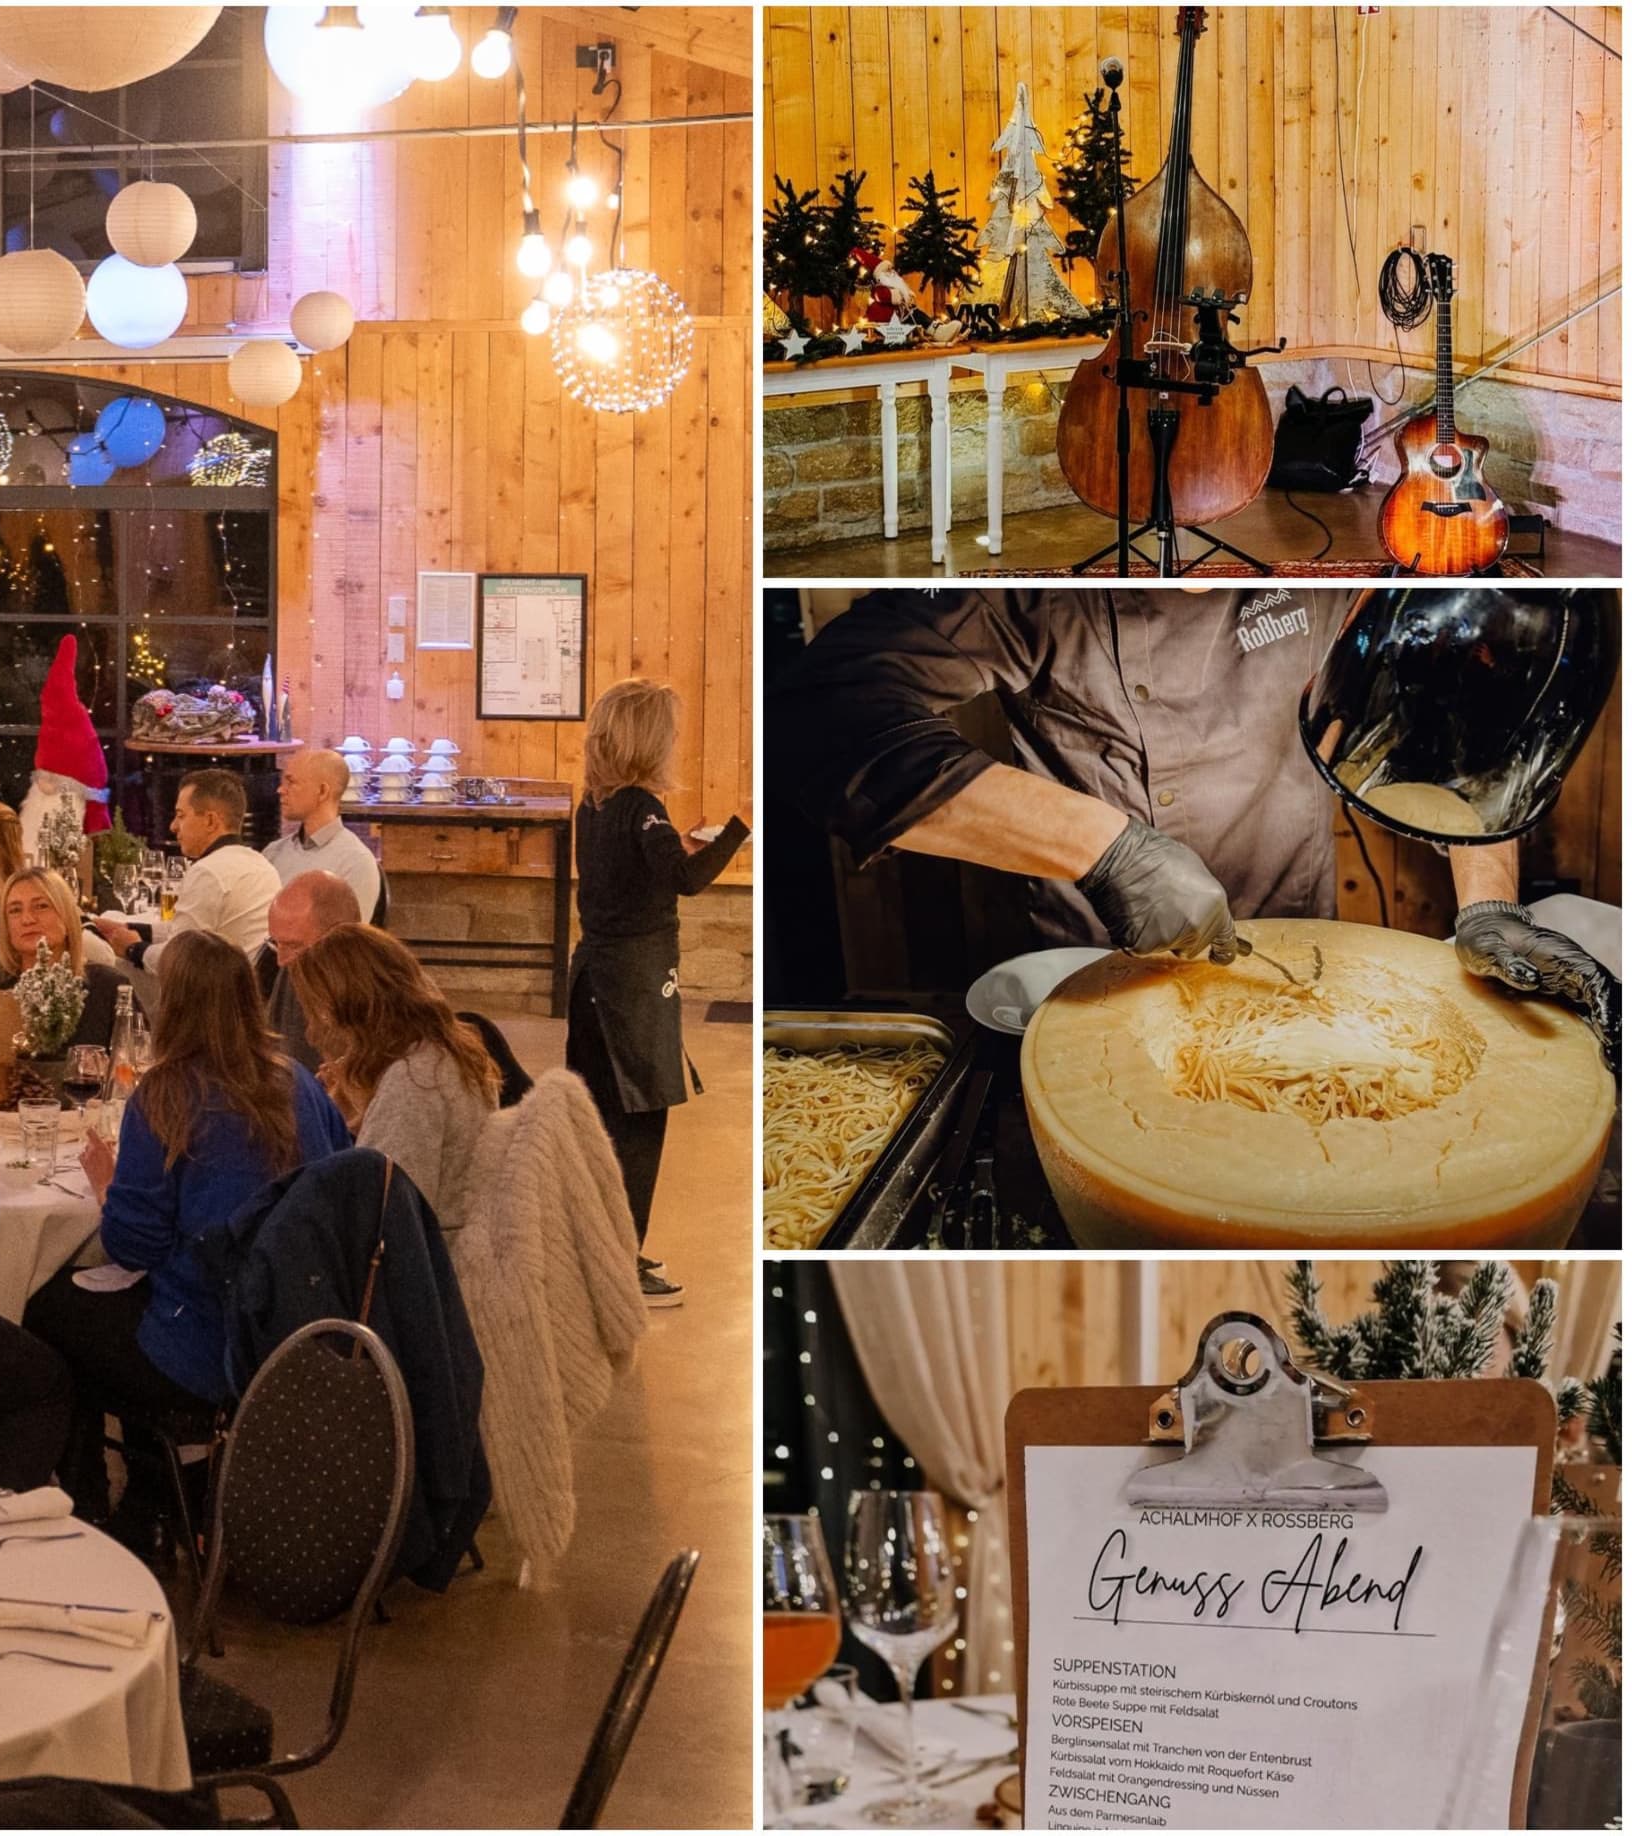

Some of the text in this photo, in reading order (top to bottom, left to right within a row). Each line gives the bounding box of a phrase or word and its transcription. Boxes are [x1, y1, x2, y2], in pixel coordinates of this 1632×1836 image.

[1236, 607, 1310, 653] Roßberg
[1139, 1511, 1354, 1529] ACHALMHOF X ROSSBERG
[1088, 1528, 1423, 1634] Genuss Abend
[1053, 1658, 1176, 1679] SUPPENSTATION
[1052, 1679, 1358, 1711] Kürbissuppe mit steirischem Kürbiskernöl und Croutons
[1052, 1695, 1219, 1719] Rote Beete Suppe mit Feldsalat
[1052, 1714, 1143, 1734] VORSPEISEN
[1051, 1734, 1312, 1767] Berglinsensalat mit Tranchen von der Entenbrust
[1050, 1751, 1294, 1783] Kürbissalat vom Hokkaido mit Roquefort Käse
[1048, 1784, 1171, 1809] ZWISCHENGANG
[1049, 1767, 1280, 1798] Feldsalat mit Orangendressing und Nüssen
[1048, 1804, 1067, 1817] Aus
[1069, 1807, 1094, 1820] dem
[1096, 1809, 1167, 1827] Parmesanlaib
